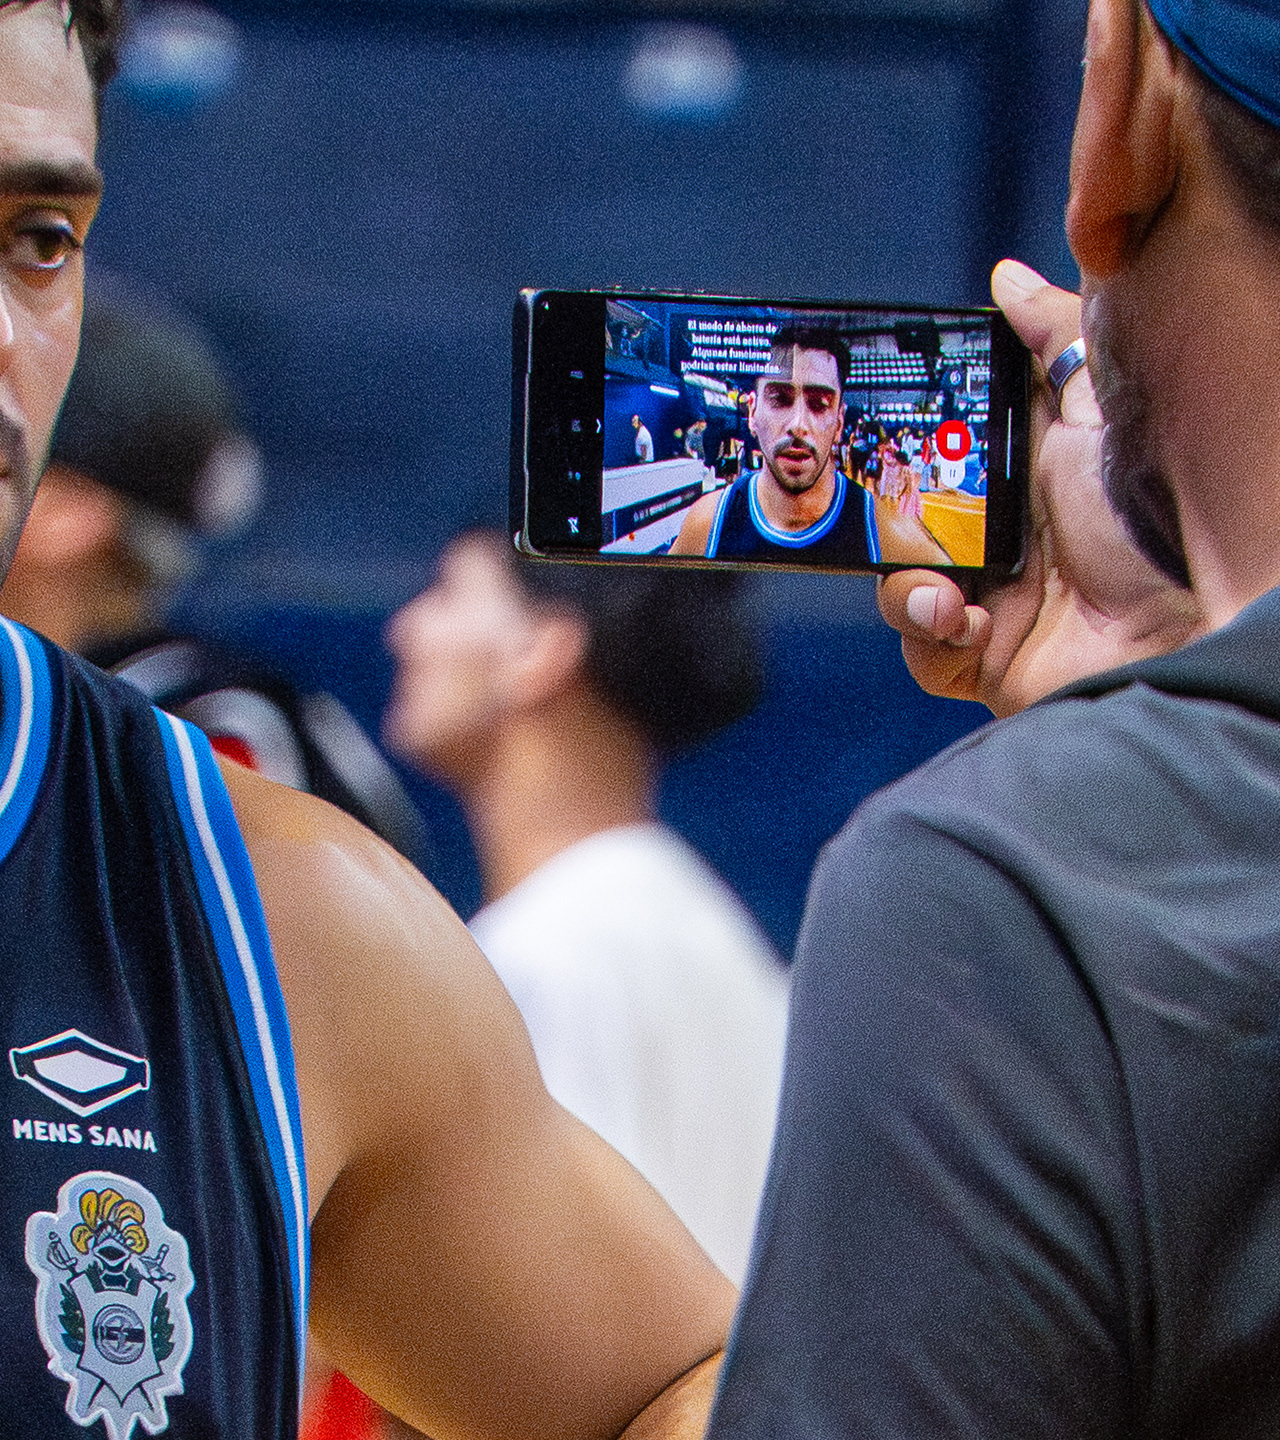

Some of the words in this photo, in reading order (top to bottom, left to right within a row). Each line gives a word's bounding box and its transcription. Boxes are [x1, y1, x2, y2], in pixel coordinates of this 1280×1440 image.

[687, 320, 697, 331] El
[699, 320, 723, 332] modo
[724, 321, 735, 333] de
[736, 321, 765, 334] ahorro
[691, 346, 728, 359] Algunas
[729, 347, 772, 361] funciones
[716, 362, 738, 374] estar
[12, 1118, 83, 1144] MENS
[88, 1125, 159, 1154] SANA
